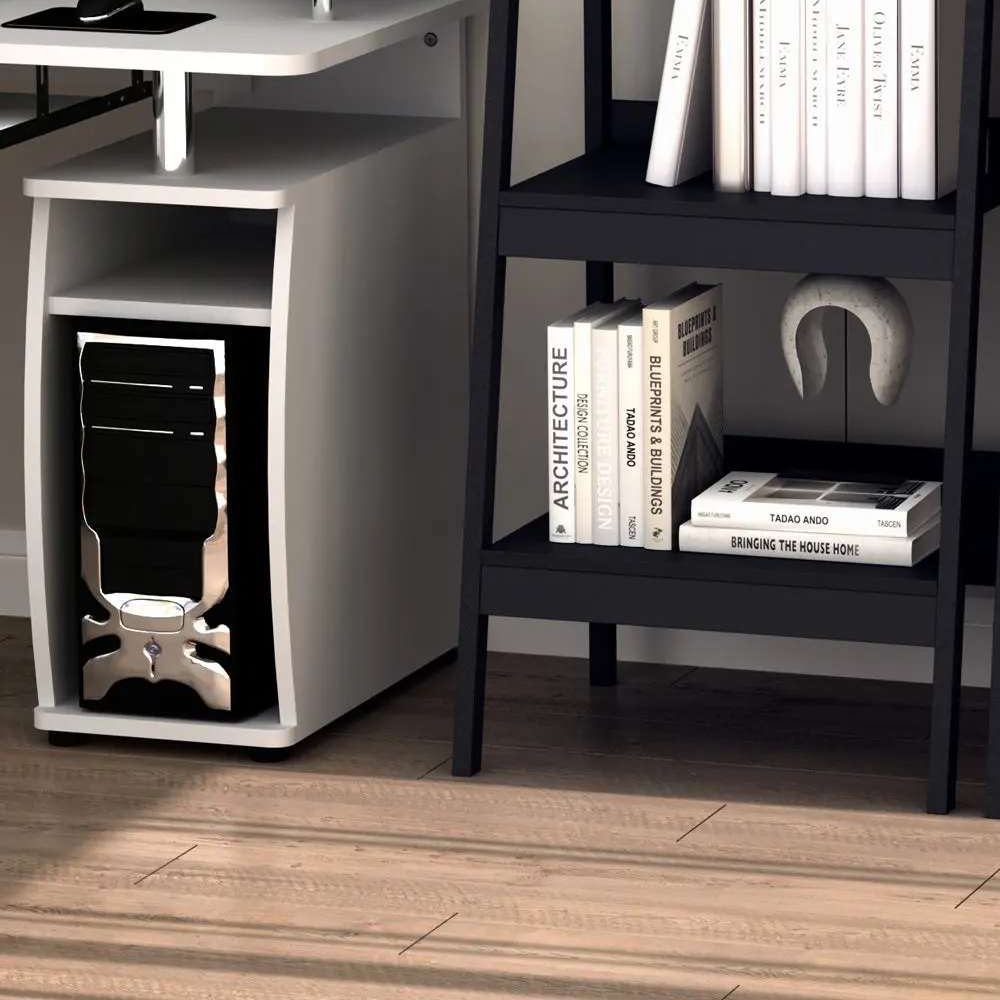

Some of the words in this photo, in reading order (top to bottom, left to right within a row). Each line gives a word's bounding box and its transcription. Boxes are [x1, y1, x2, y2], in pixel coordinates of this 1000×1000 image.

[836, 23, 850, 60] JANE
[872, 11, 886, 68] OLIVER
[872, 71, 887, 120] TWIST
[577, 393, 588, 423] DESIGN
[649, 355, 662, 432] BLUEPRINTS
[552, 347, 569, 510] ARCHITECTURE
[626, 407, 636, 438] TADAO
[577, 425, 588, 474] COLLECTION
[626, 441, 636, 467] ANDO
[650, 436, 660, 445] &
[597, 463, 612, 530] DESIGN
[650, 449, 663, 516] BUILDINGS
[628, 515, 636, 540] TASCEN
[769, 513, 801, 524] TADAO
[802, 515, 829, 526] ANDO
[877, 519, 901, 529] TASCEN
[731, 536, 776, 551] BRINGING
[779, 539, 797, 552] THE
[799, 540, 831, 555] HOUSE
[832, 542, 860, 556] HOME
